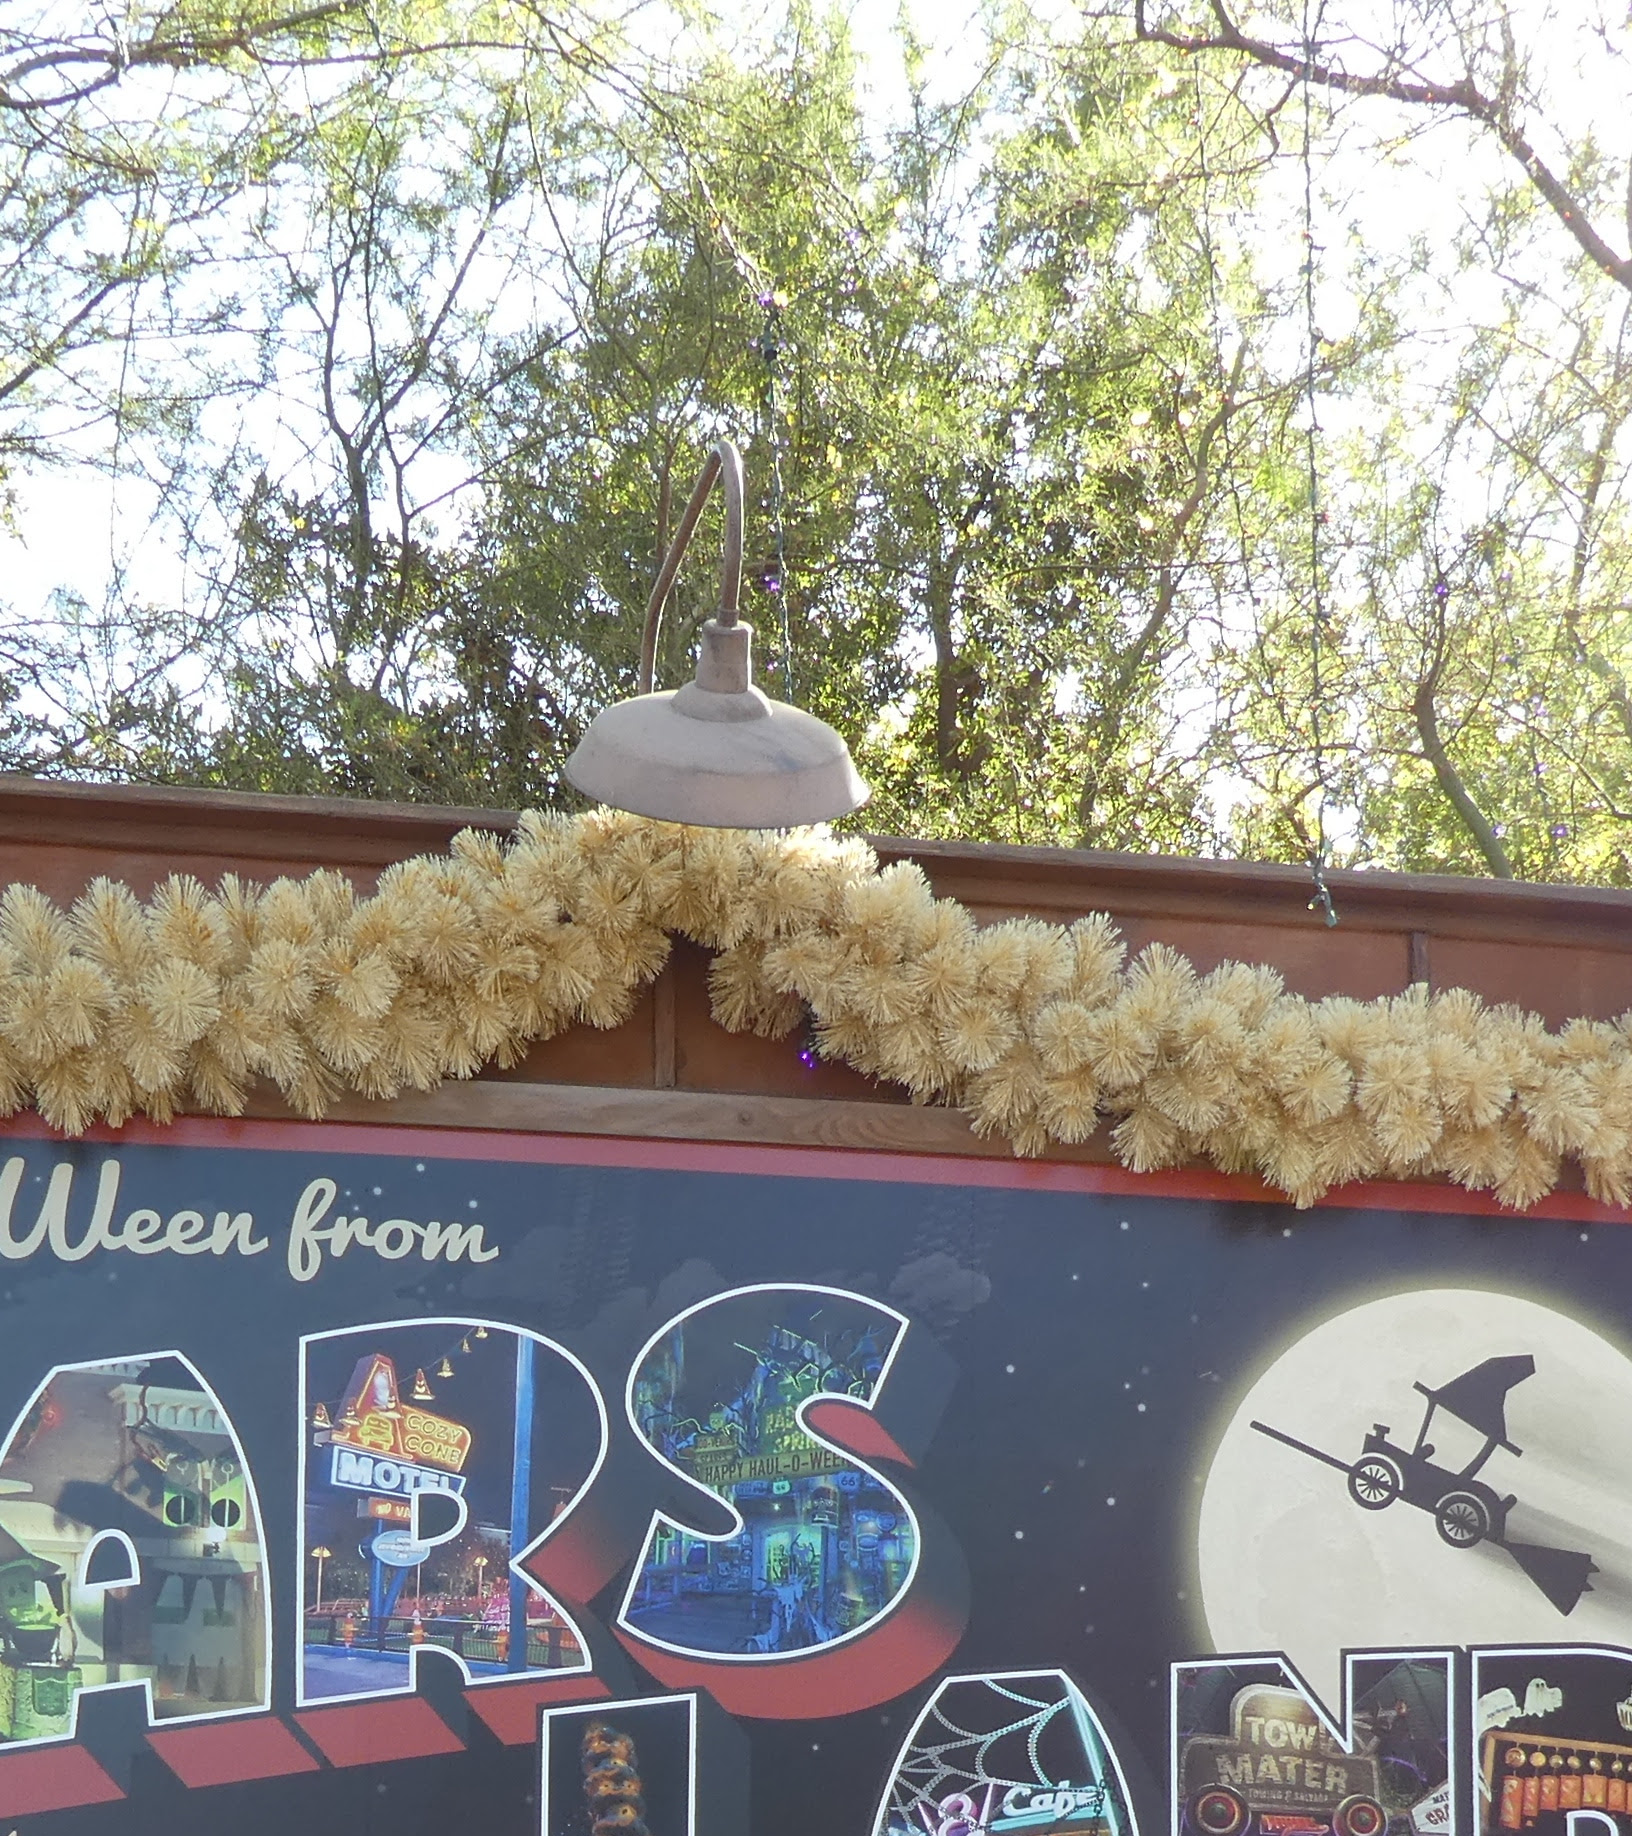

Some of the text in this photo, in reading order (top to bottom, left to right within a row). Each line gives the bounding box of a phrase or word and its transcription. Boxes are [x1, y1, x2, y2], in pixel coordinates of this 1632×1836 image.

[286, 1178, 499, 1282] from
[406, 1413, 463, 1445] COZY
[404, 1435, 462, 1464] CONE
[705, 1462, 744, 1482] HAPPY
[1245, 1716, 1318, 1751] TOW
[1215, 1752, 1349, 1794] MATER
